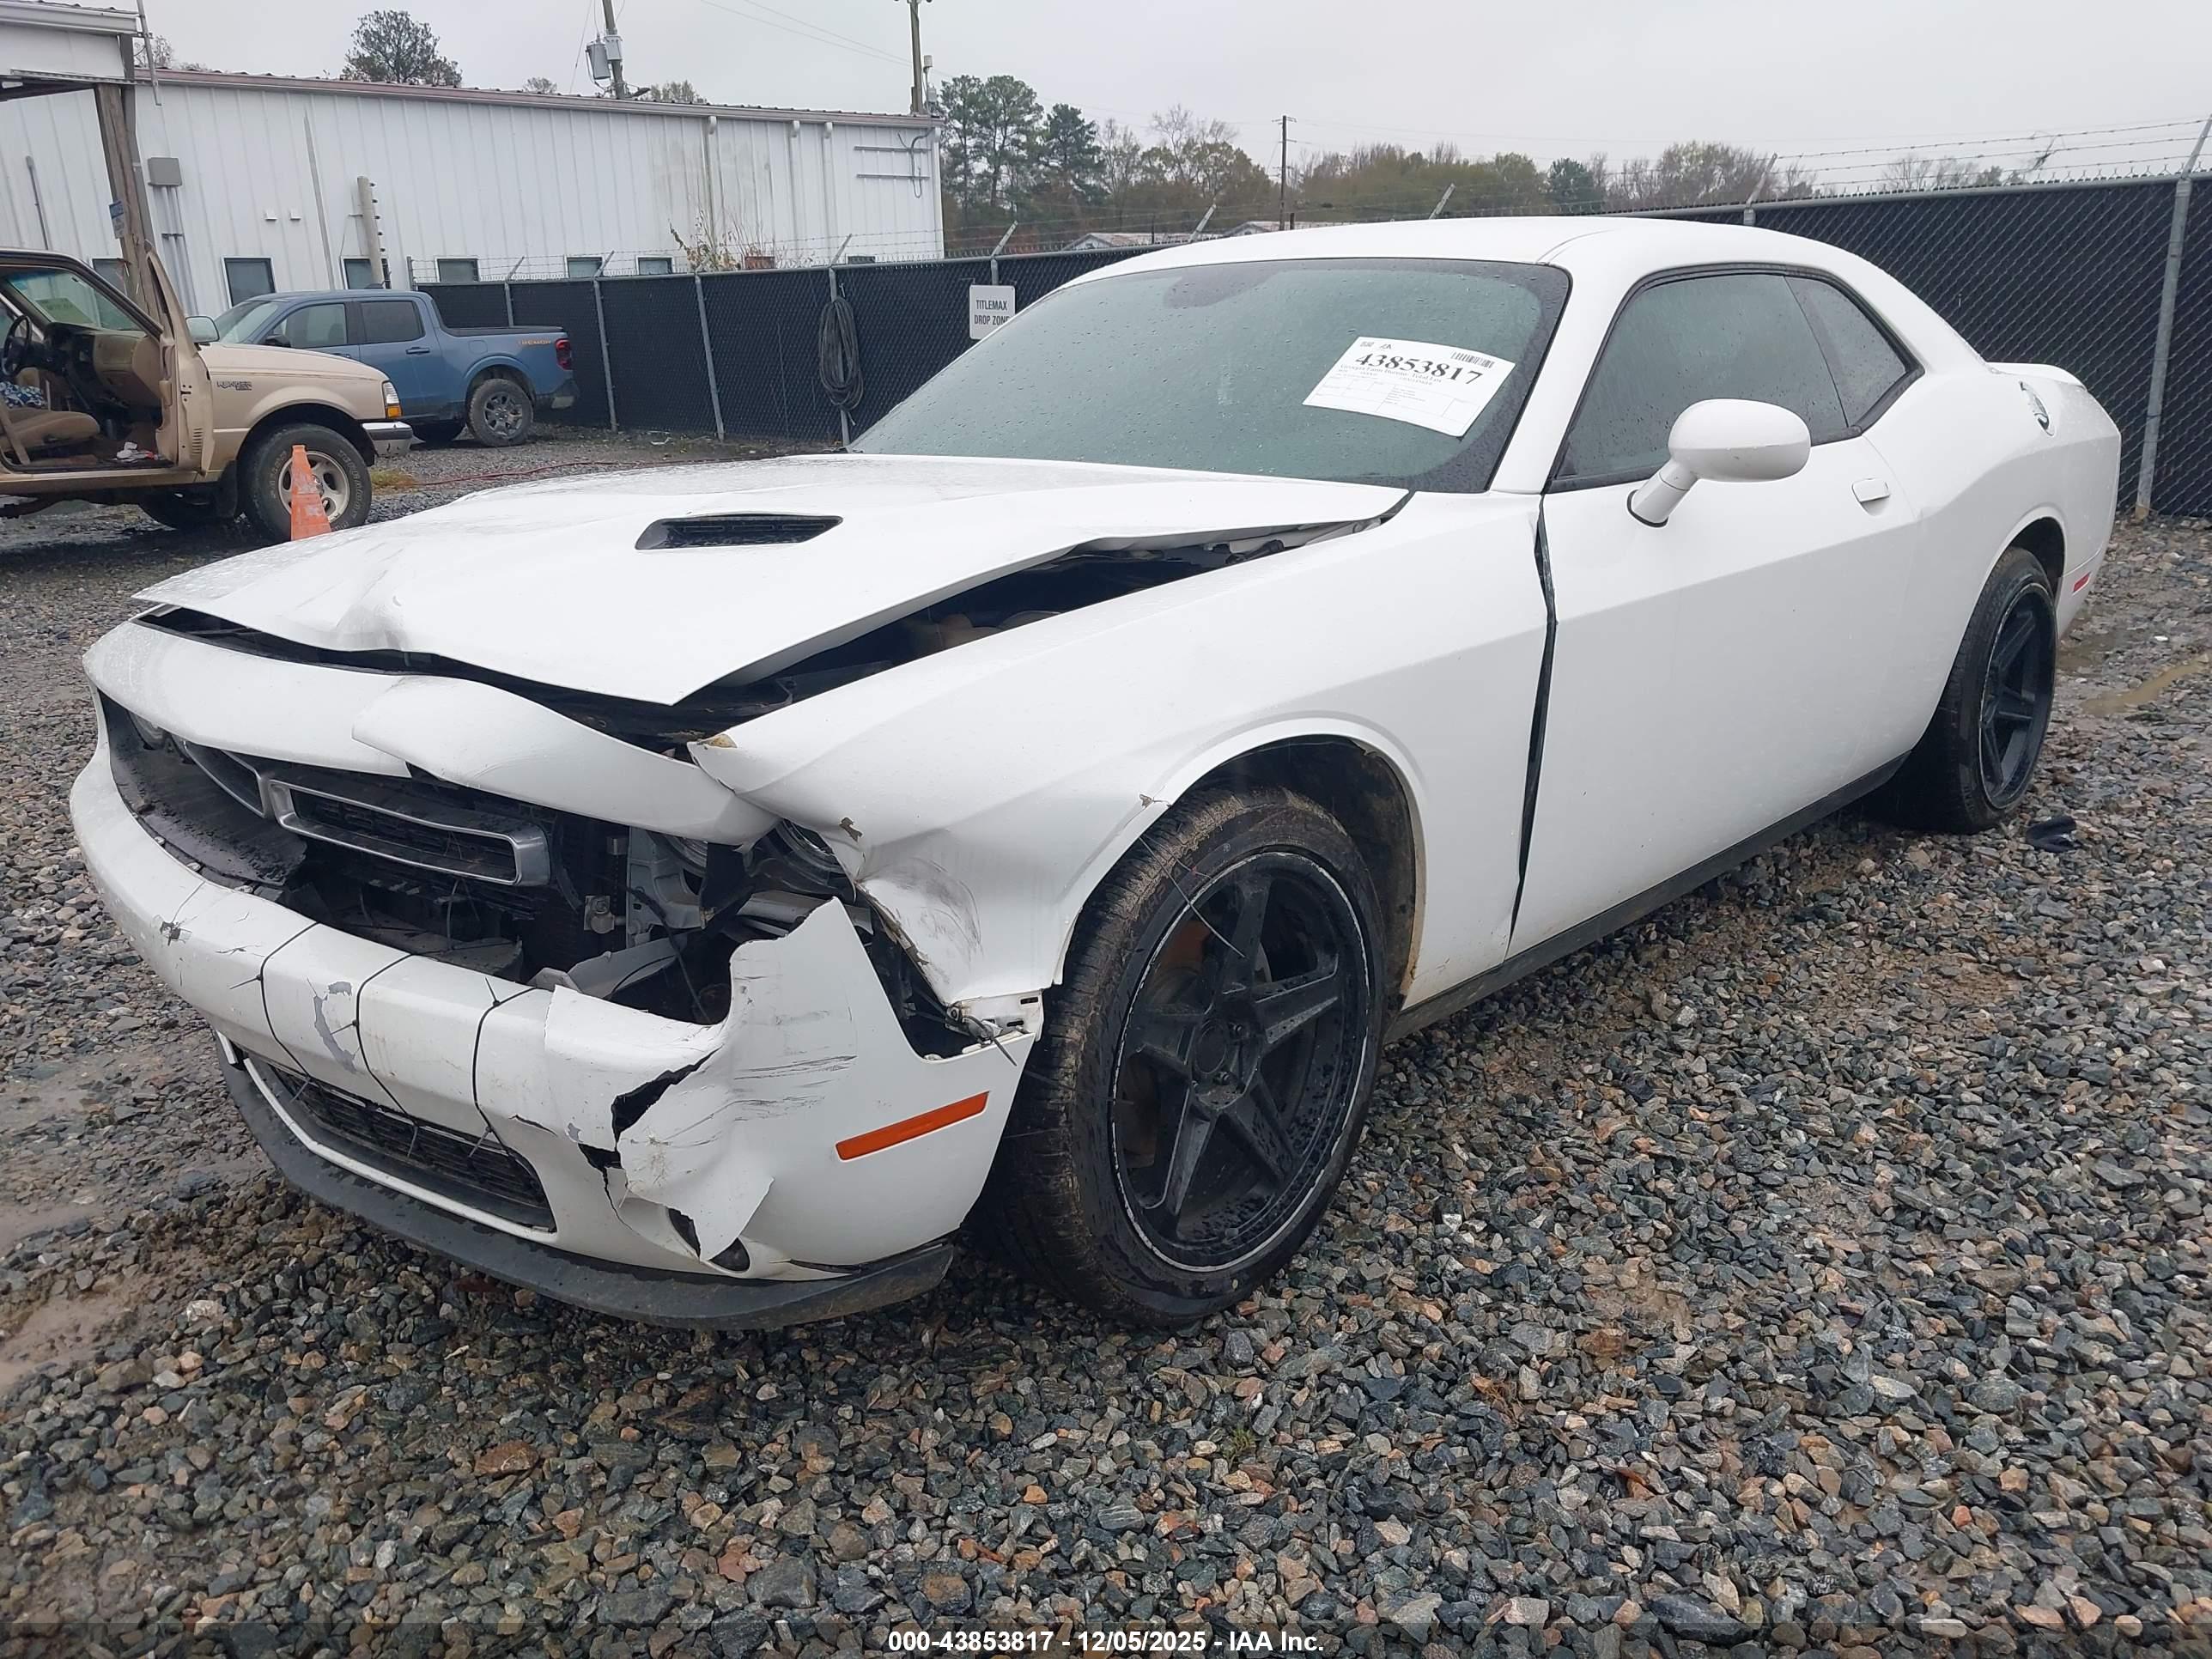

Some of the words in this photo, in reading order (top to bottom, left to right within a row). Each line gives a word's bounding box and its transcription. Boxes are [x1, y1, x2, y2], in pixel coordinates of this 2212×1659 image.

[976, 300, 1007, 310] TITLEMAX
[975, 315, 990, 325] DROP
[1355, 353, 1483, 386] 43853817
